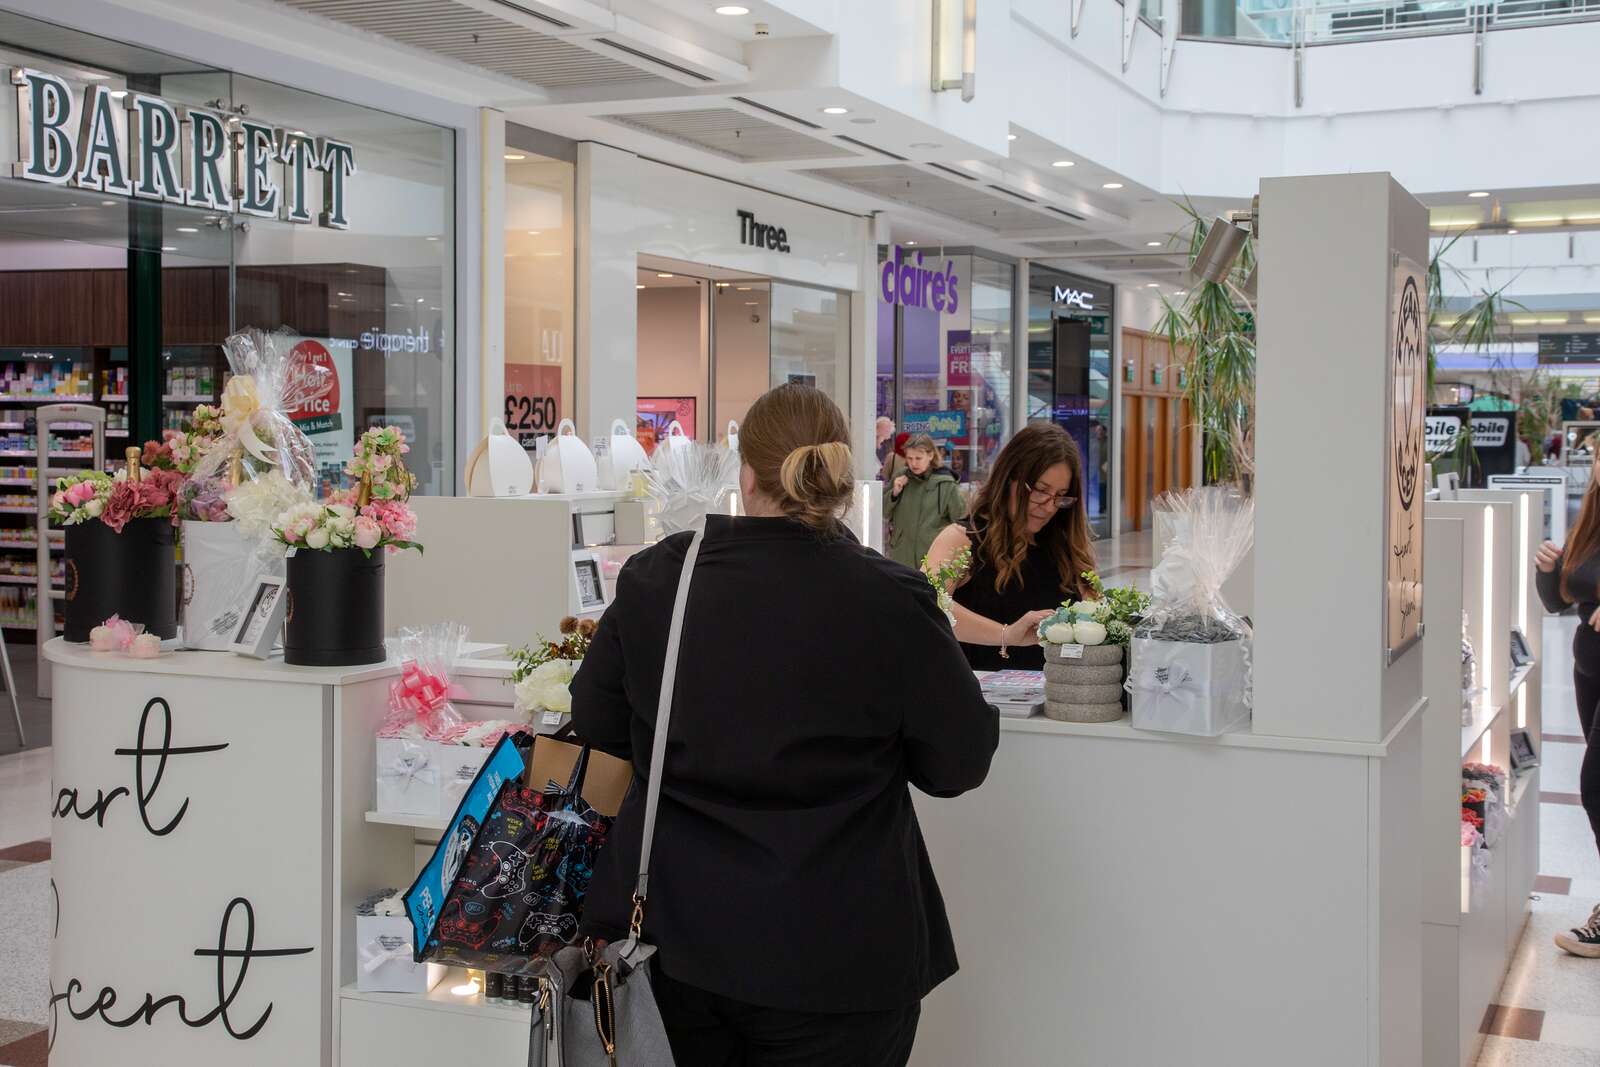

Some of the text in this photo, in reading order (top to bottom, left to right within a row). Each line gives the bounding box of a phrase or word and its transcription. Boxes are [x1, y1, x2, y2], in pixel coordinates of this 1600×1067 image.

[18, 68, 357, 230] BARRETT
[736, 208, 791, 254] Three.
[881, 244, 959, 314] claire's
[1054, 284, 1094, 310] MAC
[297, 398, 331, 413] rice
[505, 395, 556, 430] £250
[1425, 421, 1456, 436] bile
